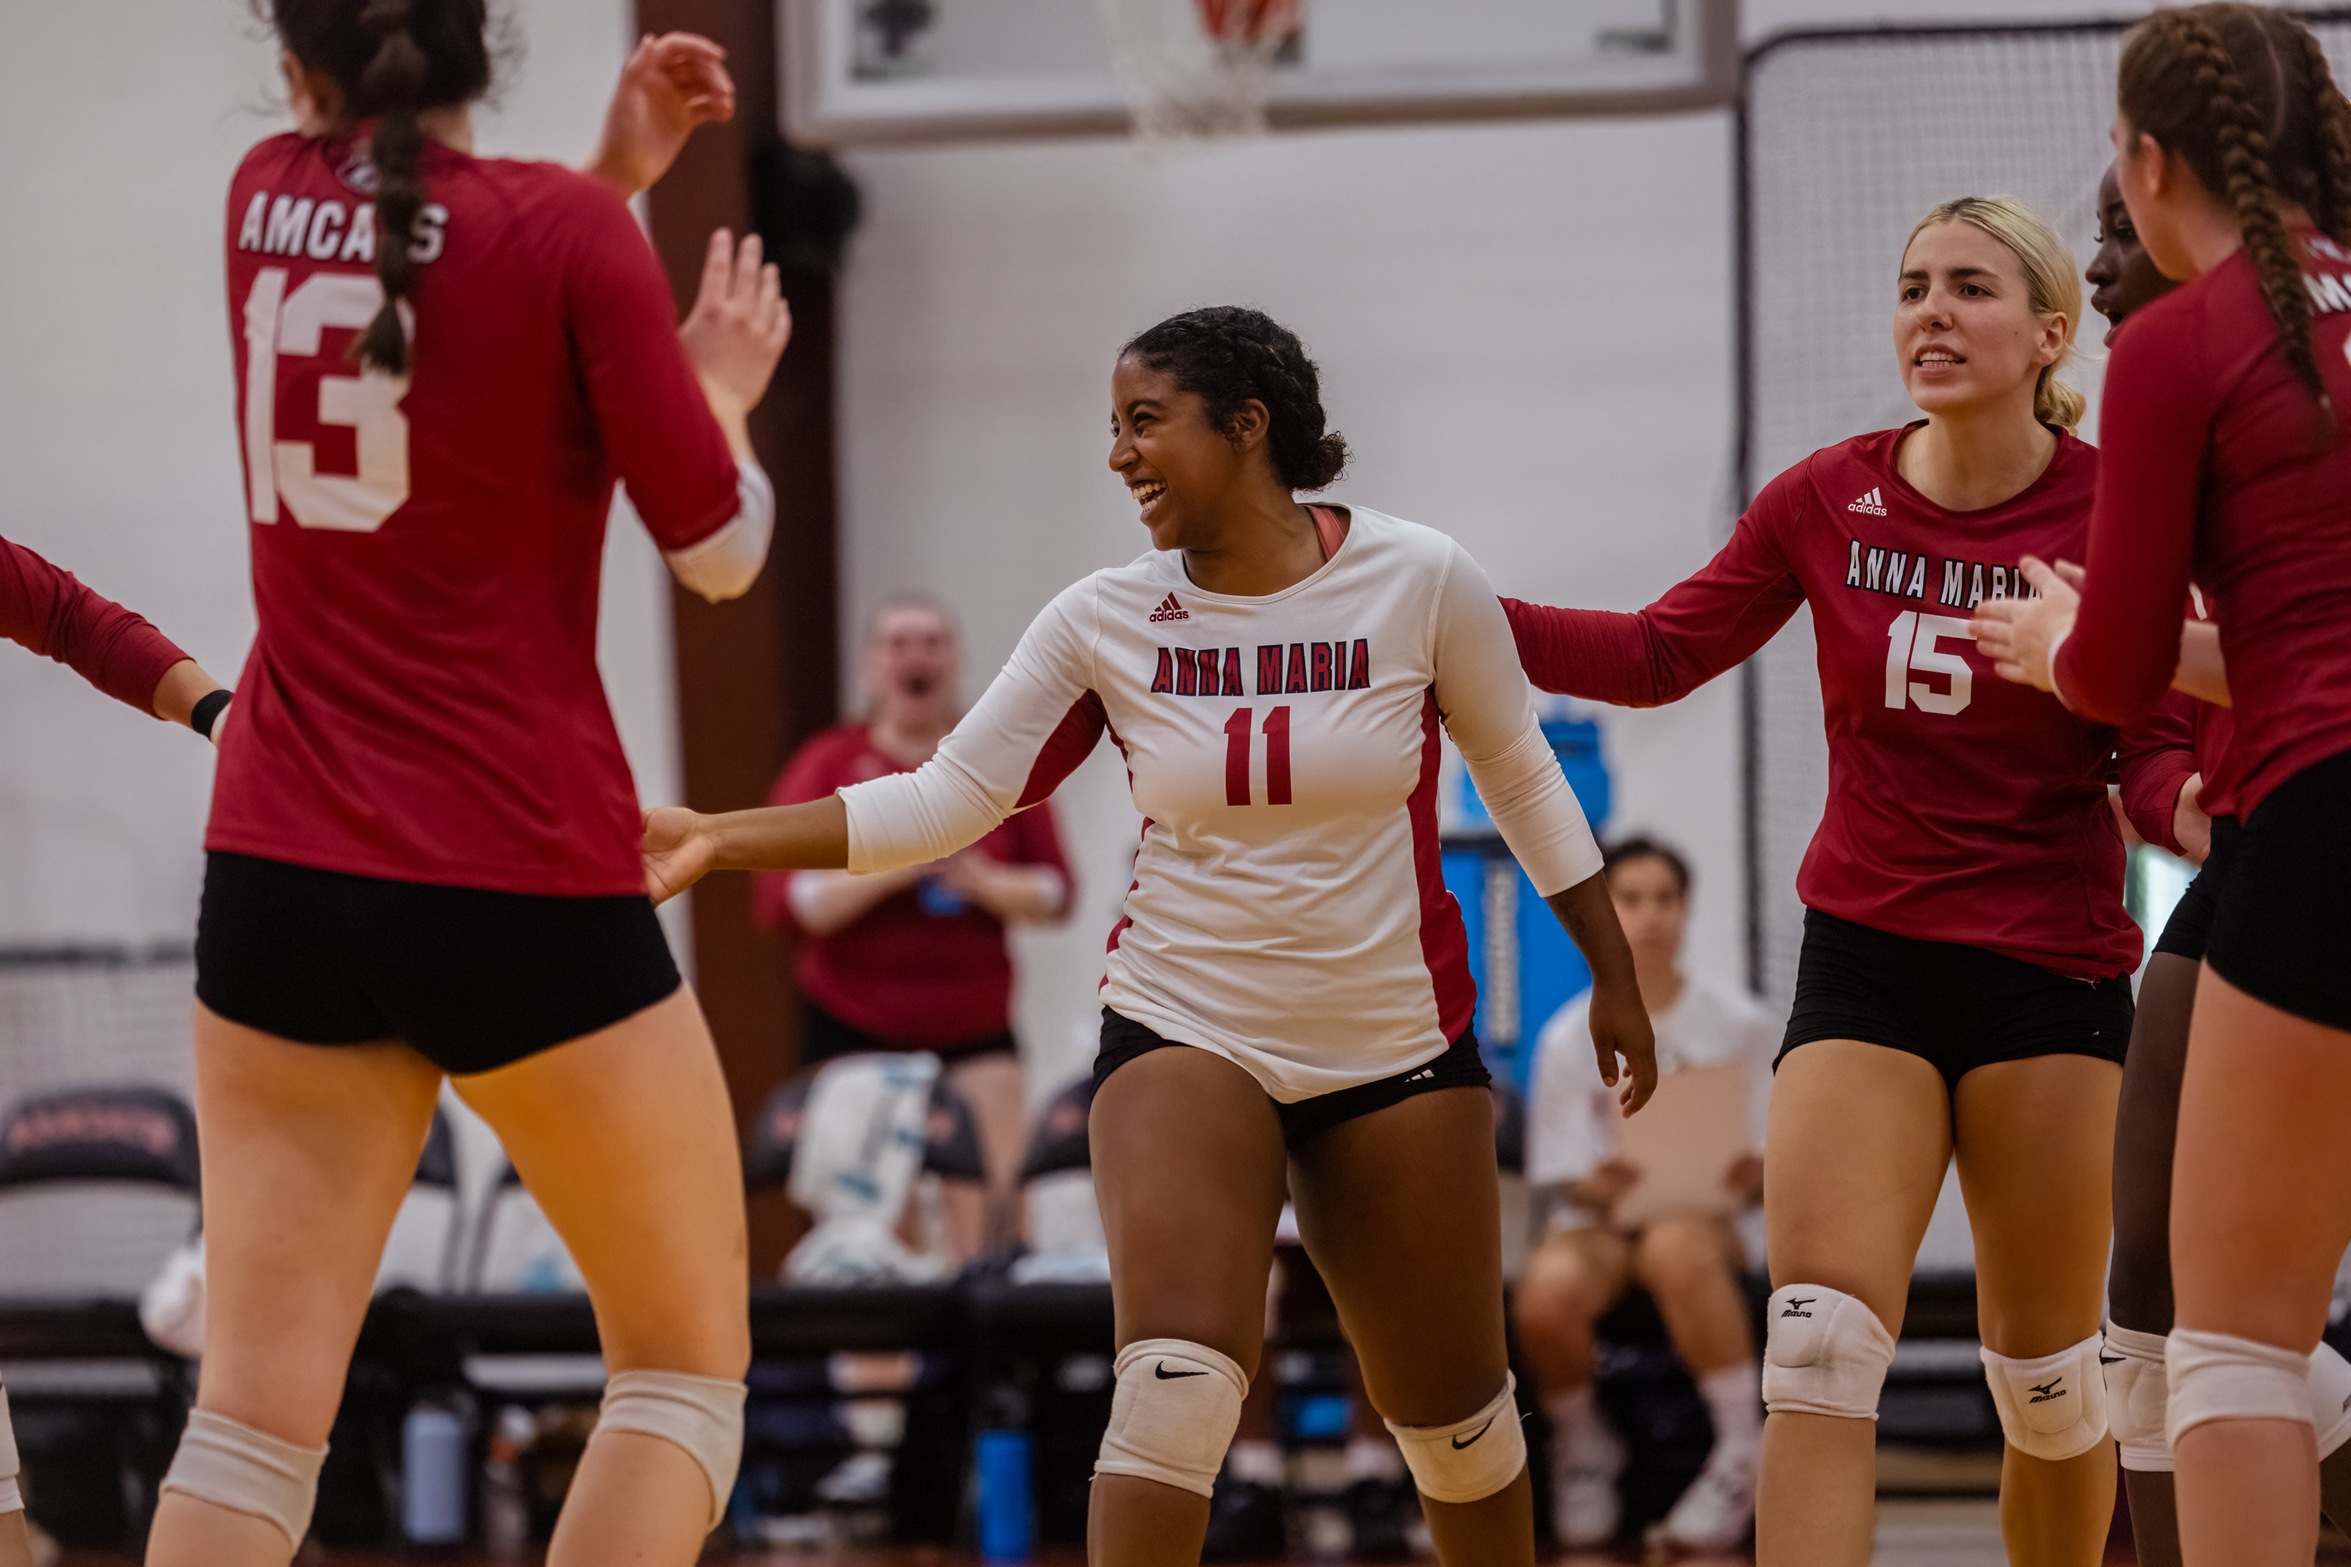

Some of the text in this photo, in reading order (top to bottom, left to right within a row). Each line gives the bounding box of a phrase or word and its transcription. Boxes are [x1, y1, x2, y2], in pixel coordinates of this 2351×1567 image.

[238, 190, 449, 264] AMCAS
[244, 267, 416, 532] 13
[1848, 502, 1888, 517] adidas
[1845, 538, 1928, 602] ANNA
[1149, 608, 1190, 623] adidas
[1150, 638, 1371, 697] ANNA MARIA
[1884, 610, 1977, 716] 15
[1223, 705, 1293, 806] 11
